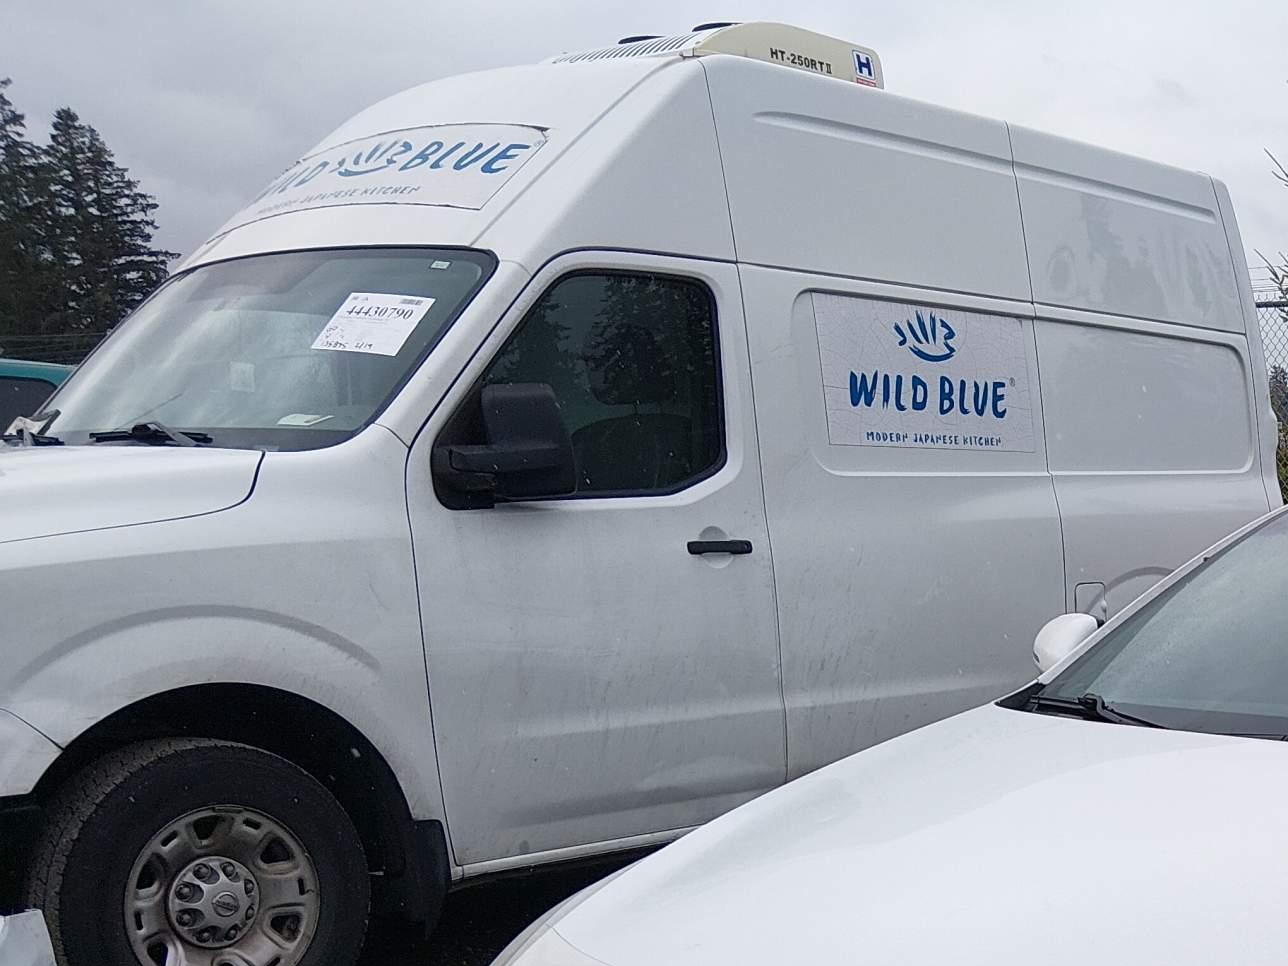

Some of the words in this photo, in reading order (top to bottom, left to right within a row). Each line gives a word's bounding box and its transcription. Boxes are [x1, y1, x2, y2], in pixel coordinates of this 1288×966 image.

[856, 54, 873, 77] H
[398, 141, 530, 174] BLUE
[360, 184, 421, 197] KITCHEN
[346, 305, 414, 320] 44430790
[849, 369, 929, 412] WILD
[939, 375, 1008, 419] BLUE
[866, 431, 908, 443] MODERN
[913, 433, 960, 446] JAPANESE
[963, 435, 1002, 447] KITCHEN
